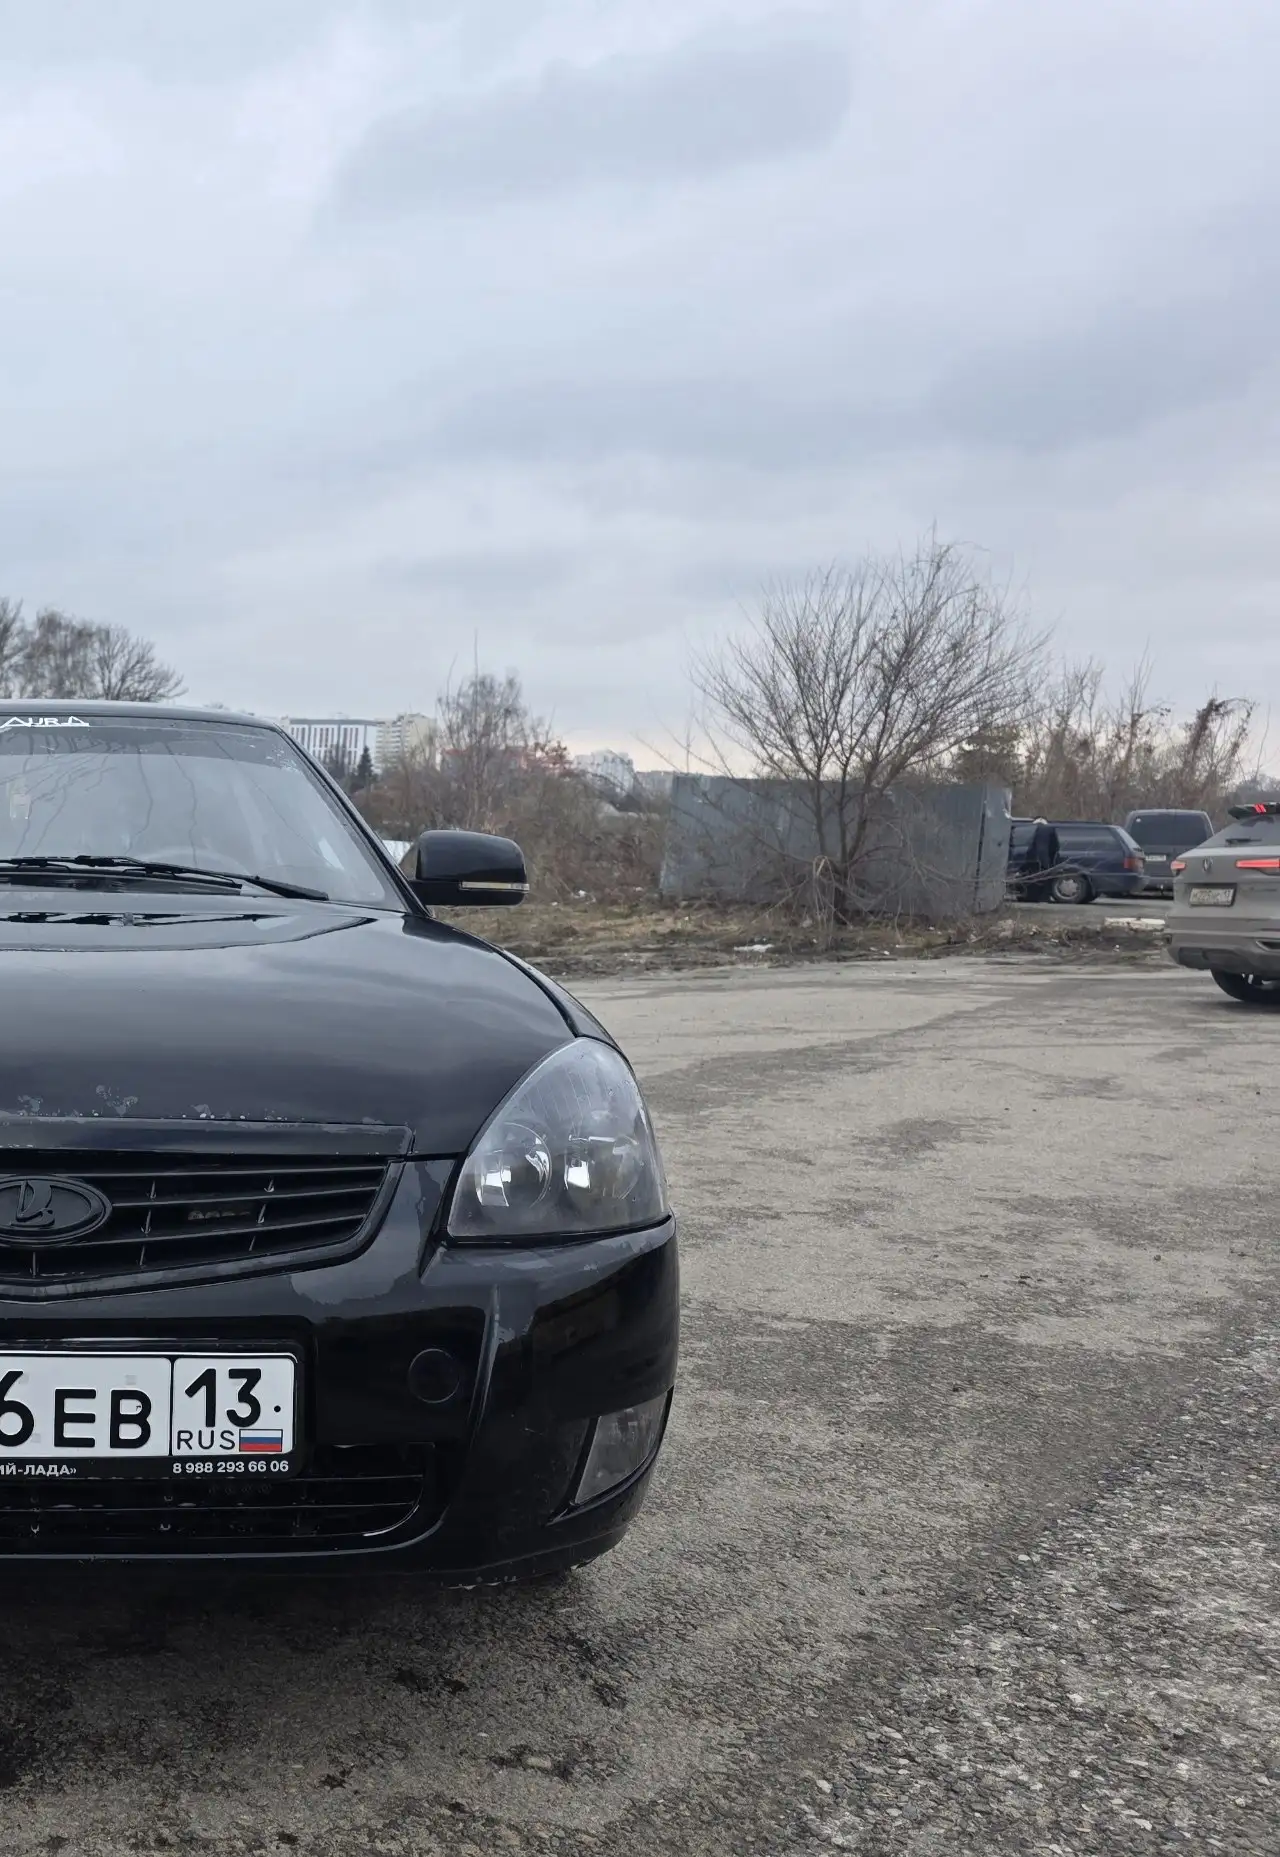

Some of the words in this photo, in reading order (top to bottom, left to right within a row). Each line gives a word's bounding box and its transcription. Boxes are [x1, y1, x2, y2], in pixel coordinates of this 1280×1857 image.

[184, 1368, 262, 1428] 13
[177, 1429, 236, 1451] RUS
[172, 1462, 182, 1474] 8
[185, 1462, 213, 1474] 988
[216, 1461, 245, 1473] 293
[247, 1460, 267, 1472] 66
[269, 1460, 289, 1472] 06
